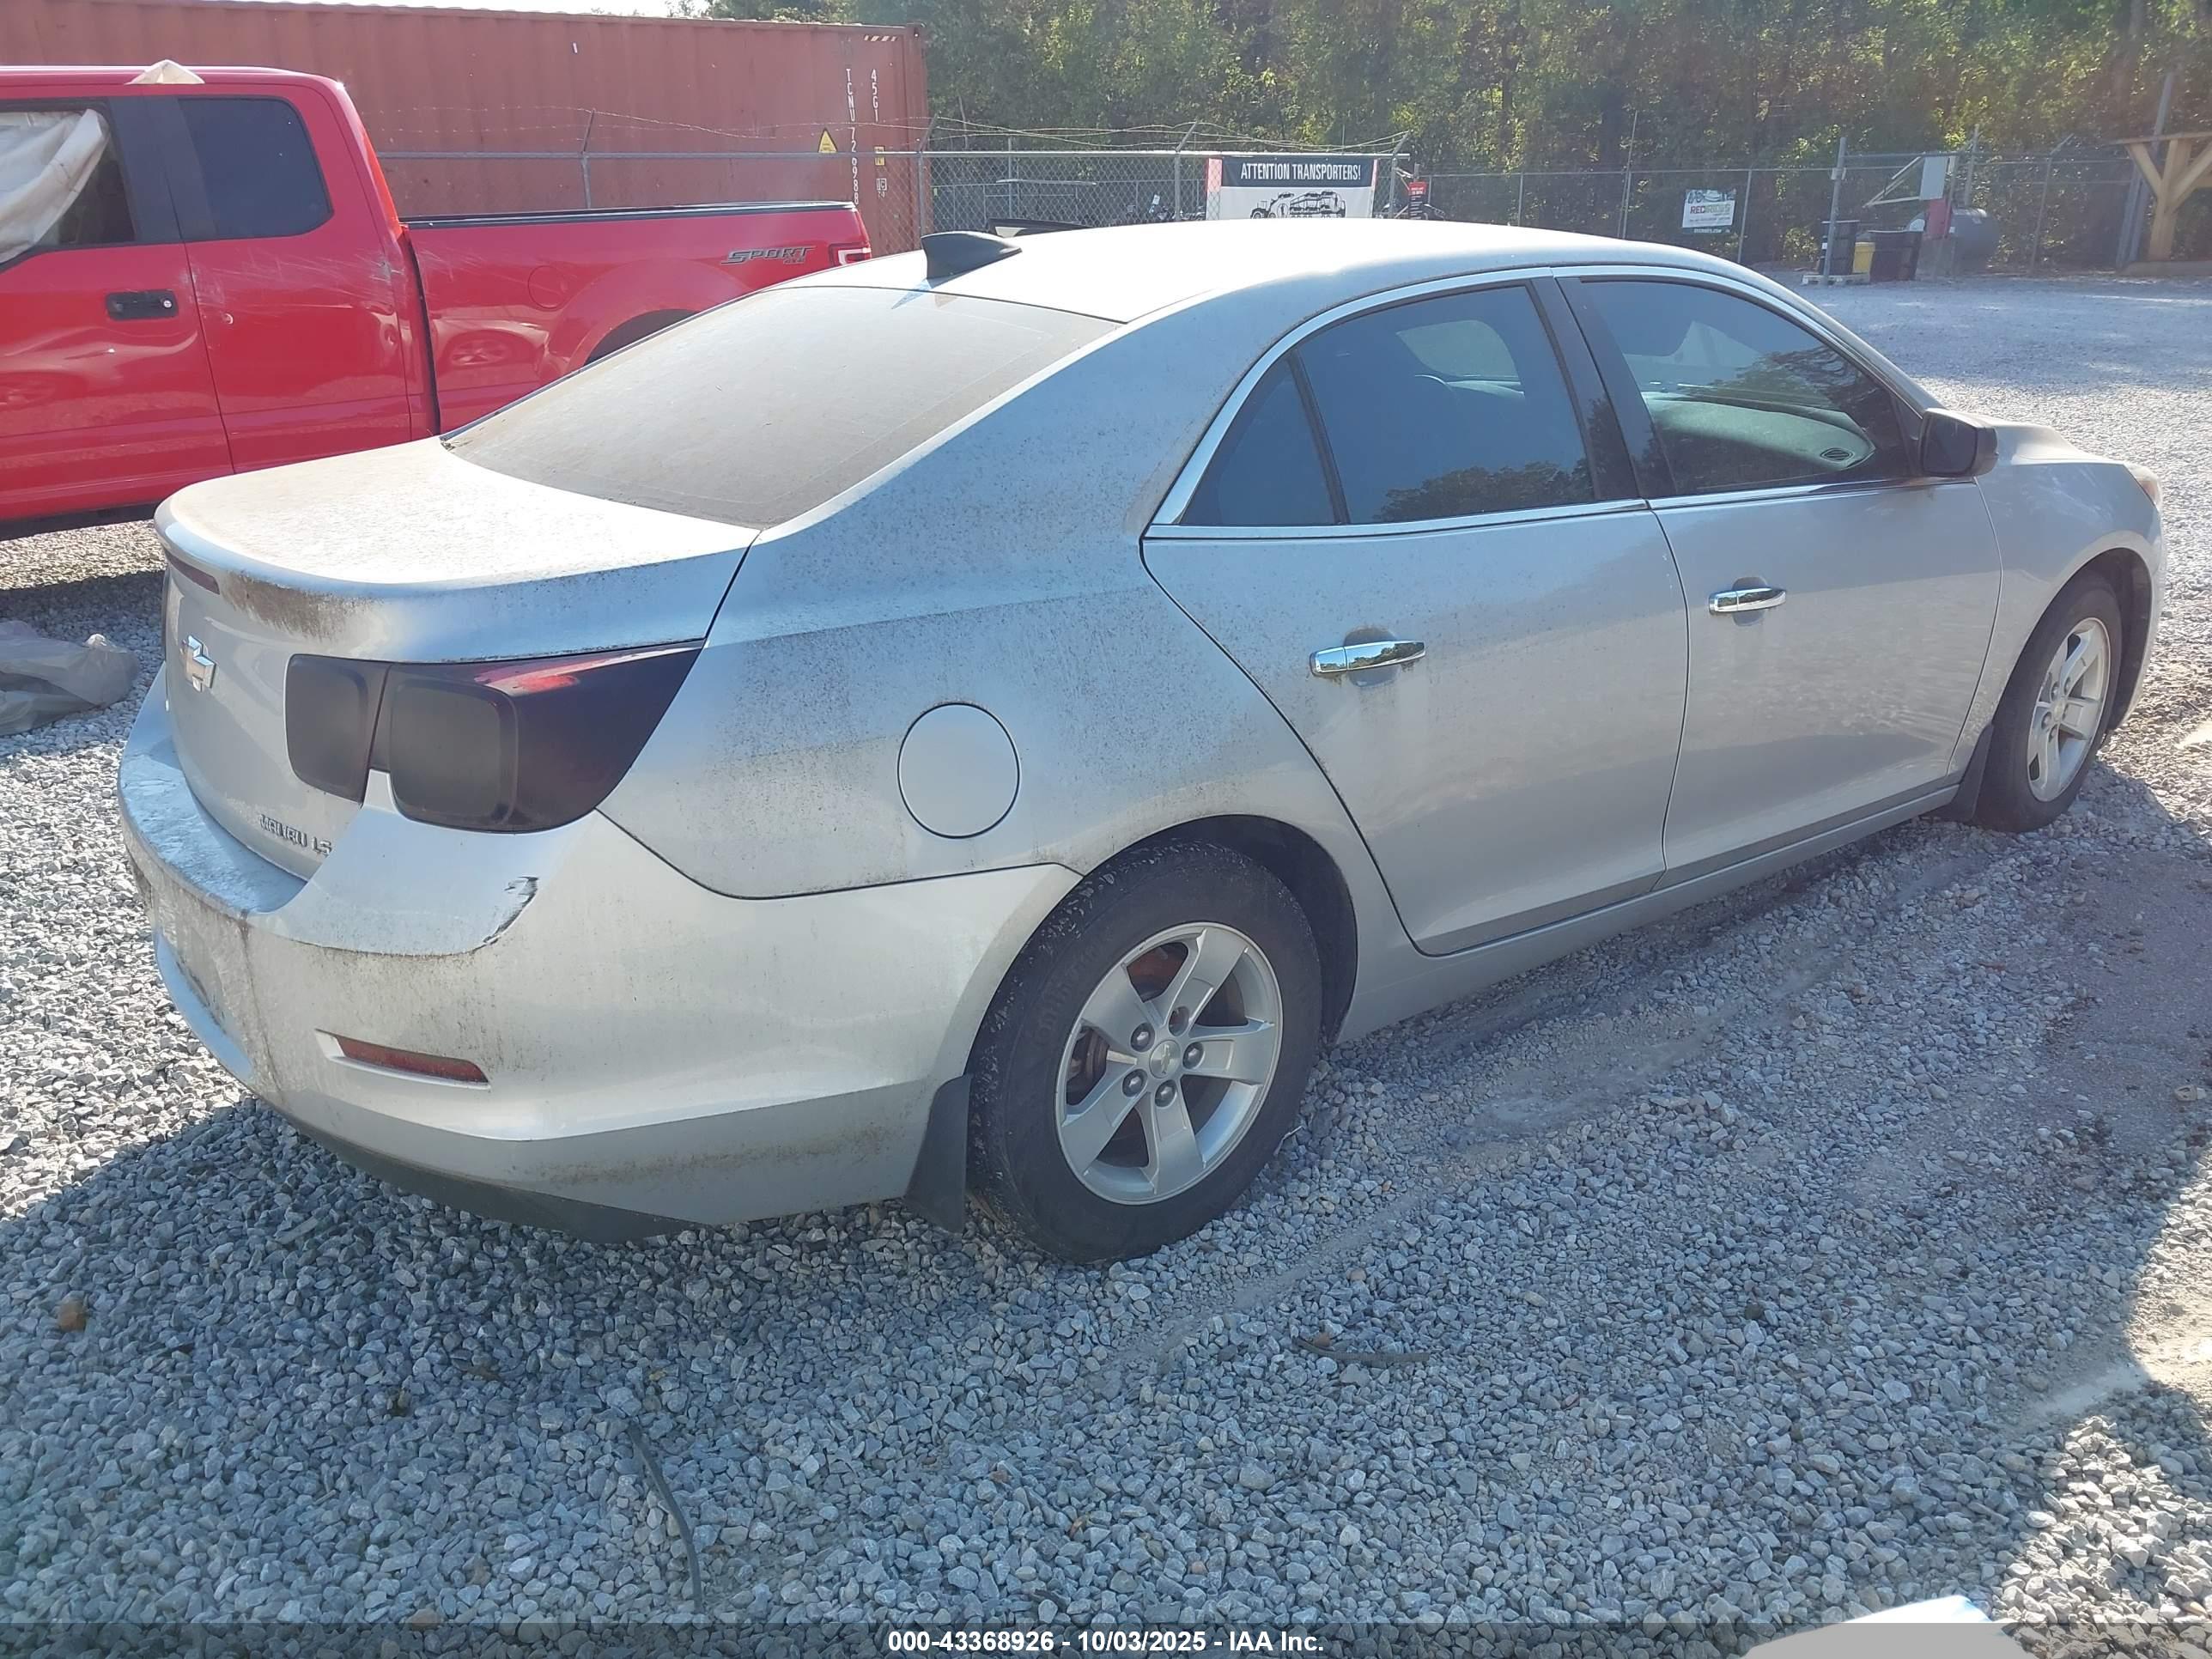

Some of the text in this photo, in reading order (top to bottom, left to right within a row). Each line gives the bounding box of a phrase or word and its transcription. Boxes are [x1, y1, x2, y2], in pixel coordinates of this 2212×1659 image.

[846, 68, 855, 122] TCNU
[1240, 162, 1361, 180] ATTENTION TRANSPORTERS!
[720, 246, 817, 265] SPORT
[259, 814, 332, 858] MALIBU LS
